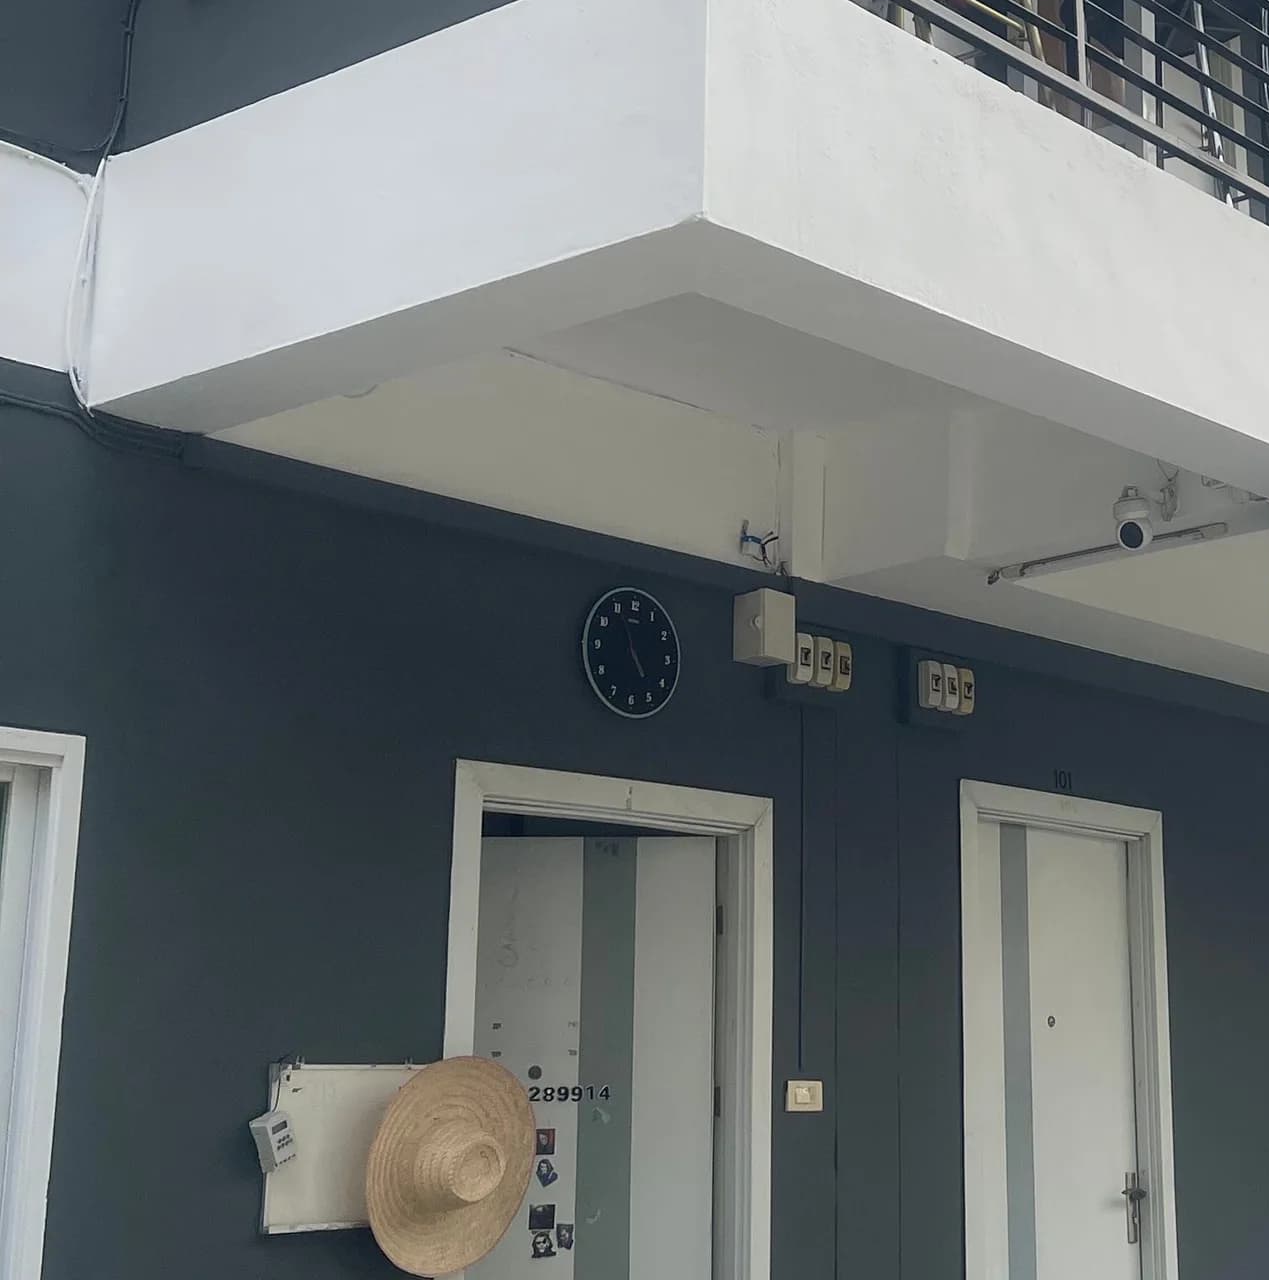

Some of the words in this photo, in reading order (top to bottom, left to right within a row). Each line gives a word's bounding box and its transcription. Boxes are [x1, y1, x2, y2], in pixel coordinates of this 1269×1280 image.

[650, 611, 655, 622] 1
[661, 630, 667, 641] 2
[594, 639, 601, 650] 9
[664, 655, 671, 665] 3
[659, 678, 665, 688] 4
[611, 685, 617, 696] 7
[628, 695, 635, 705] 6
[646, 692, 652, 703] 5
